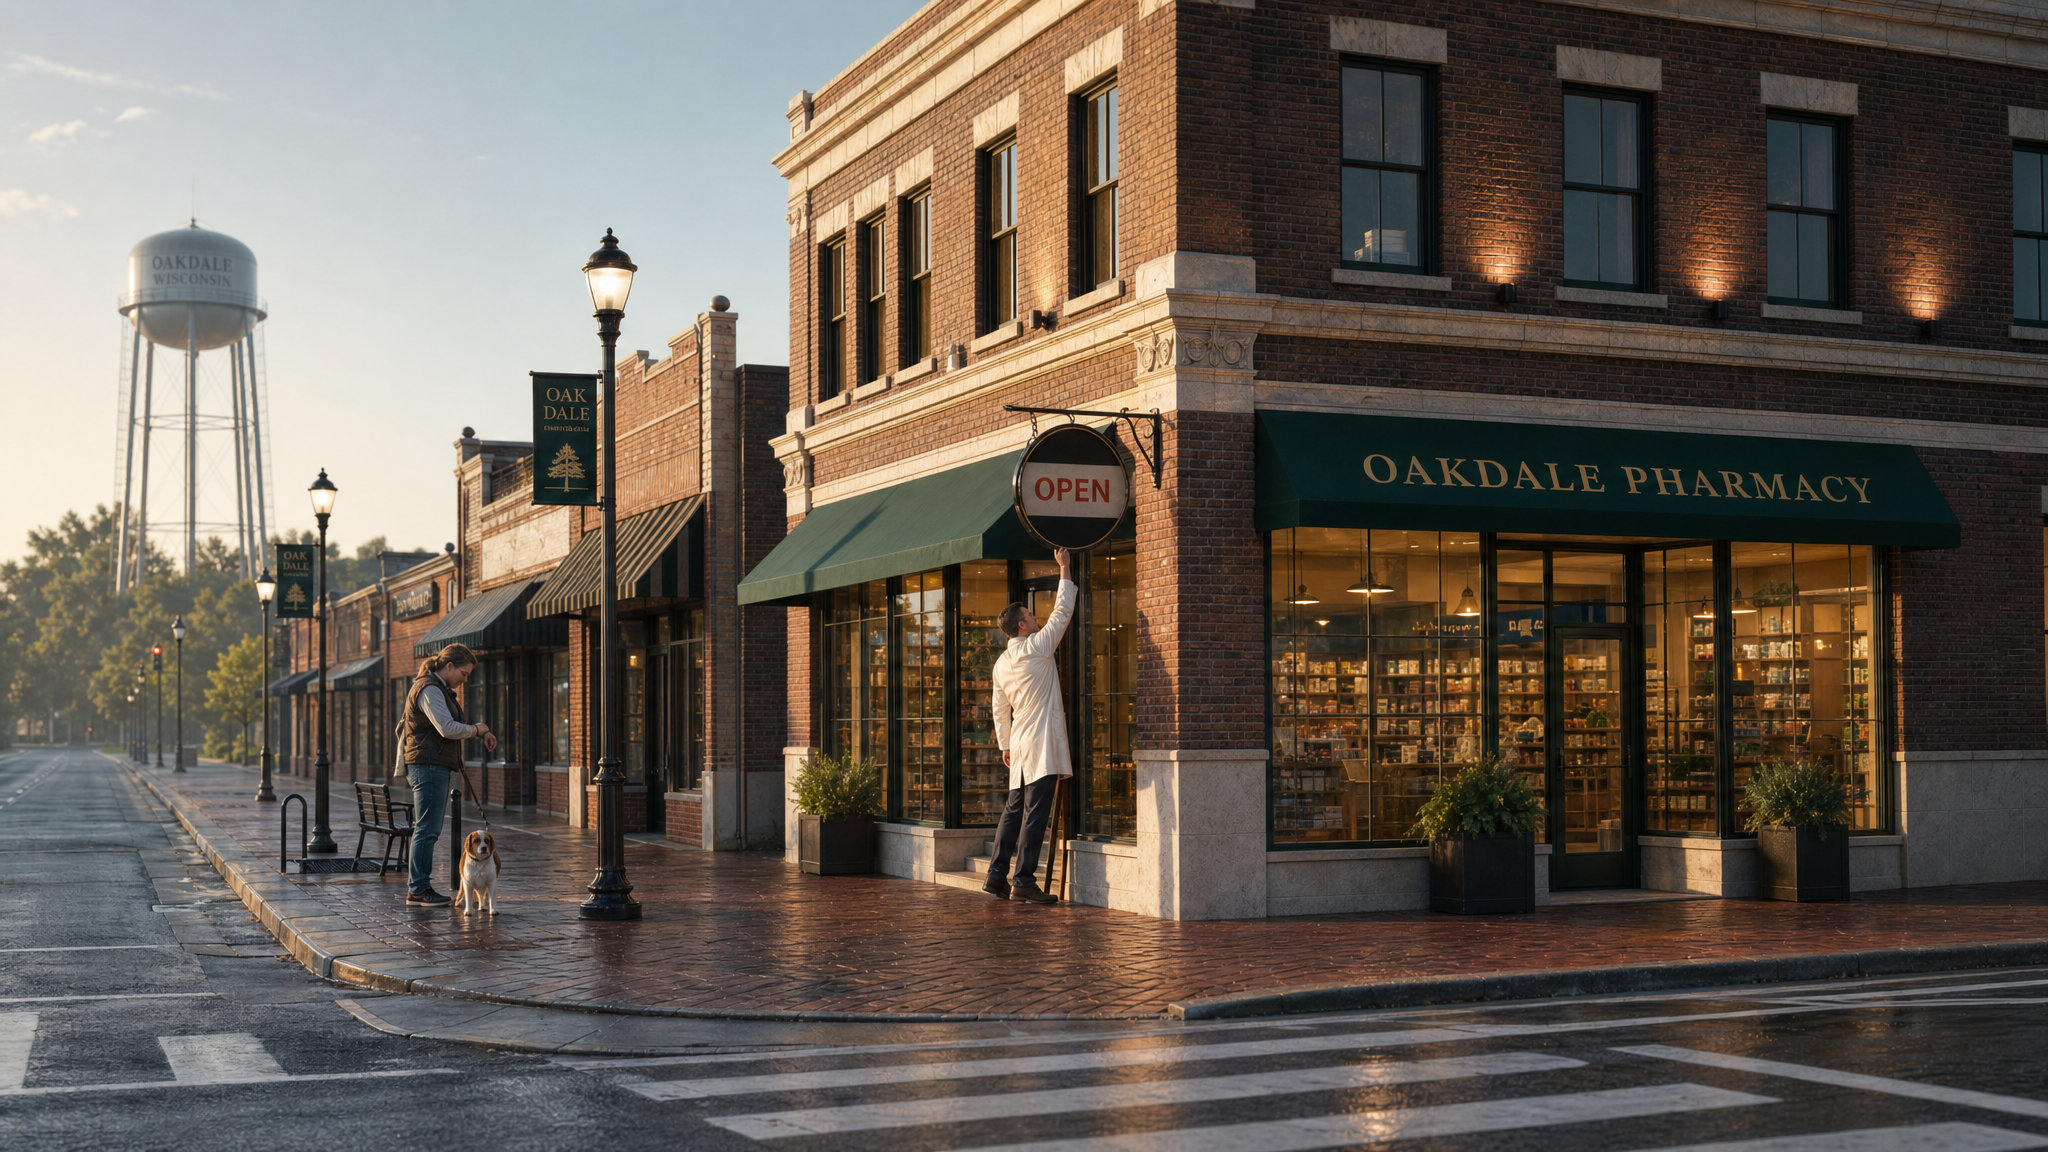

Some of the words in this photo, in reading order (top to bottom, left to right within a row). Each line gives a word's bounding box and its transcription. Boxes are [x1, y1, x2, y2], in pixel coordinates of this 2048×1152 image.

[152, 255, 233, 272] OAKDALE
[153, 273, 231, 287] WISCONSIN
[546, 387, 588, 403] OAK
[543, 405, 590, 421] DALE
[1363, 453, 1605, 493] OAKDALE
[1620, 465, 1872, 504] PHARMACY
[1034, 476, 1110, 503] OPEN
[283, 551, 307, 560] OAK
[283, 561, 309, 570] DALE
